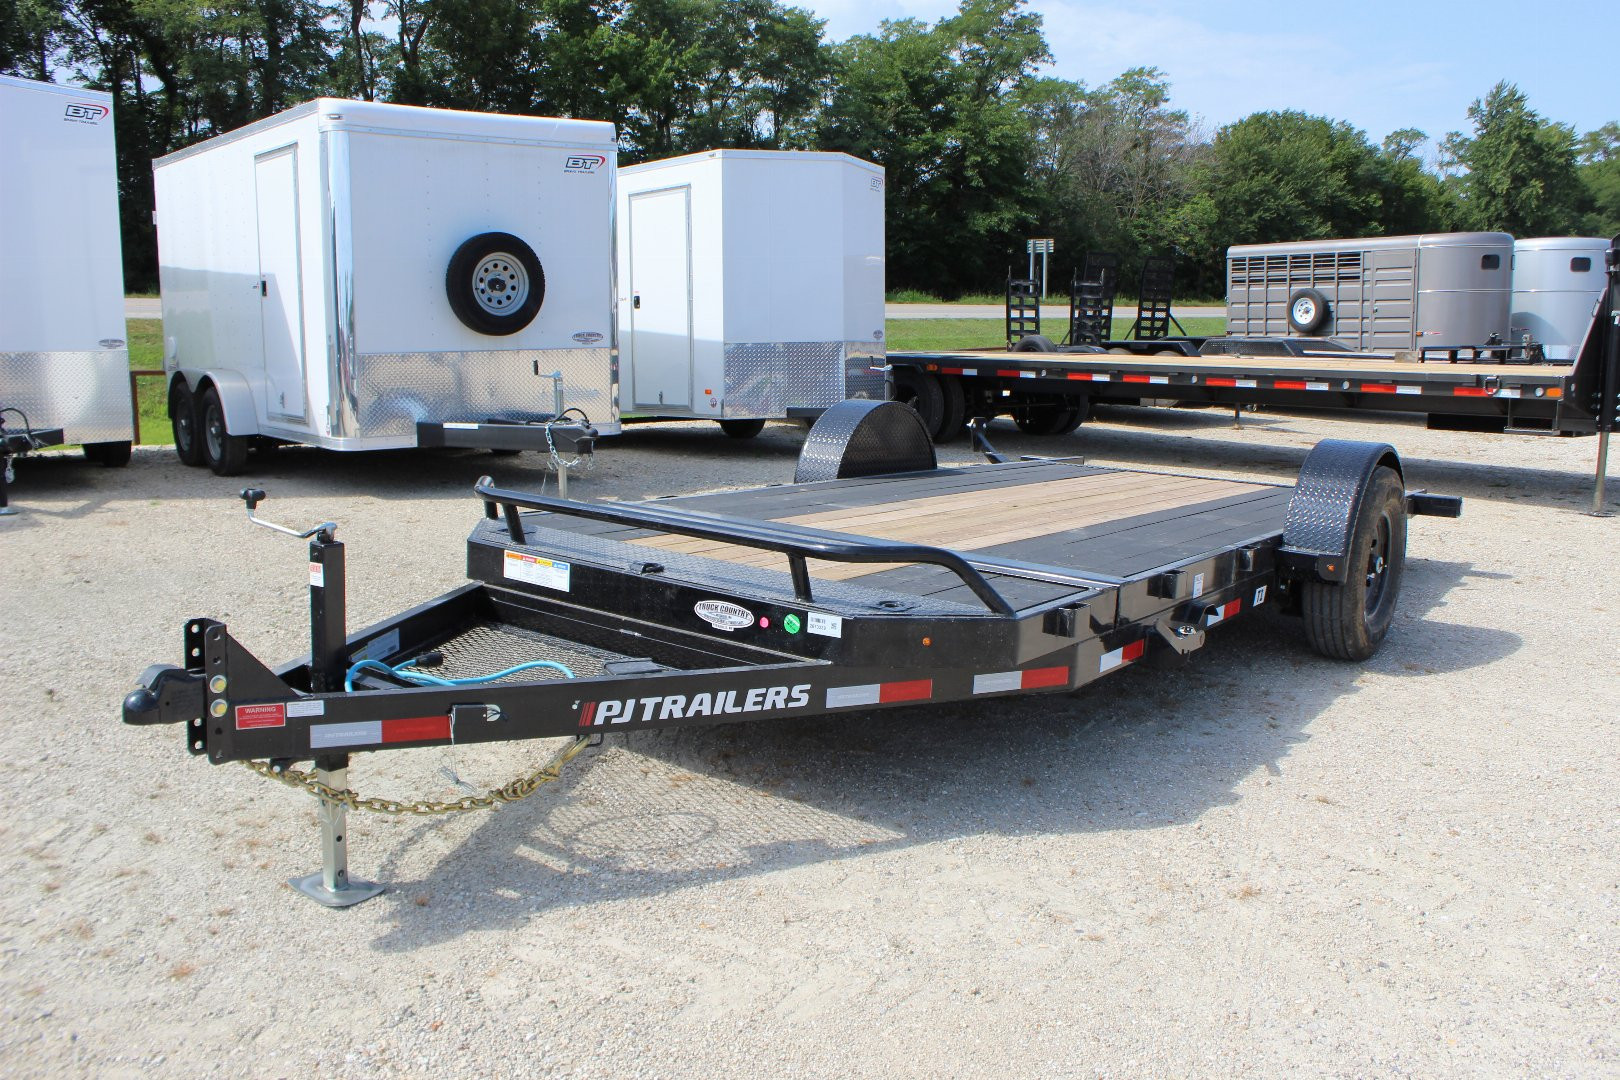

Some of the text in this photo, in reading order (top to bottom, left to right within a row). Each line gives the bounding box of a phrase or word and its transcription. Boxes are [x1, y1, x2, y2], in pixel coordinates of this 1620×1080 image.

[65, 104, 102, 120] BT
[565, 157, 600, 170] BT
[698, 602, 720, 611] TRUCK
[720, 604, 750, 619] COUNTRY
[244, 706, 276, 714] WARNING
[593, 683, 812, 726] PJ TRAILERS
